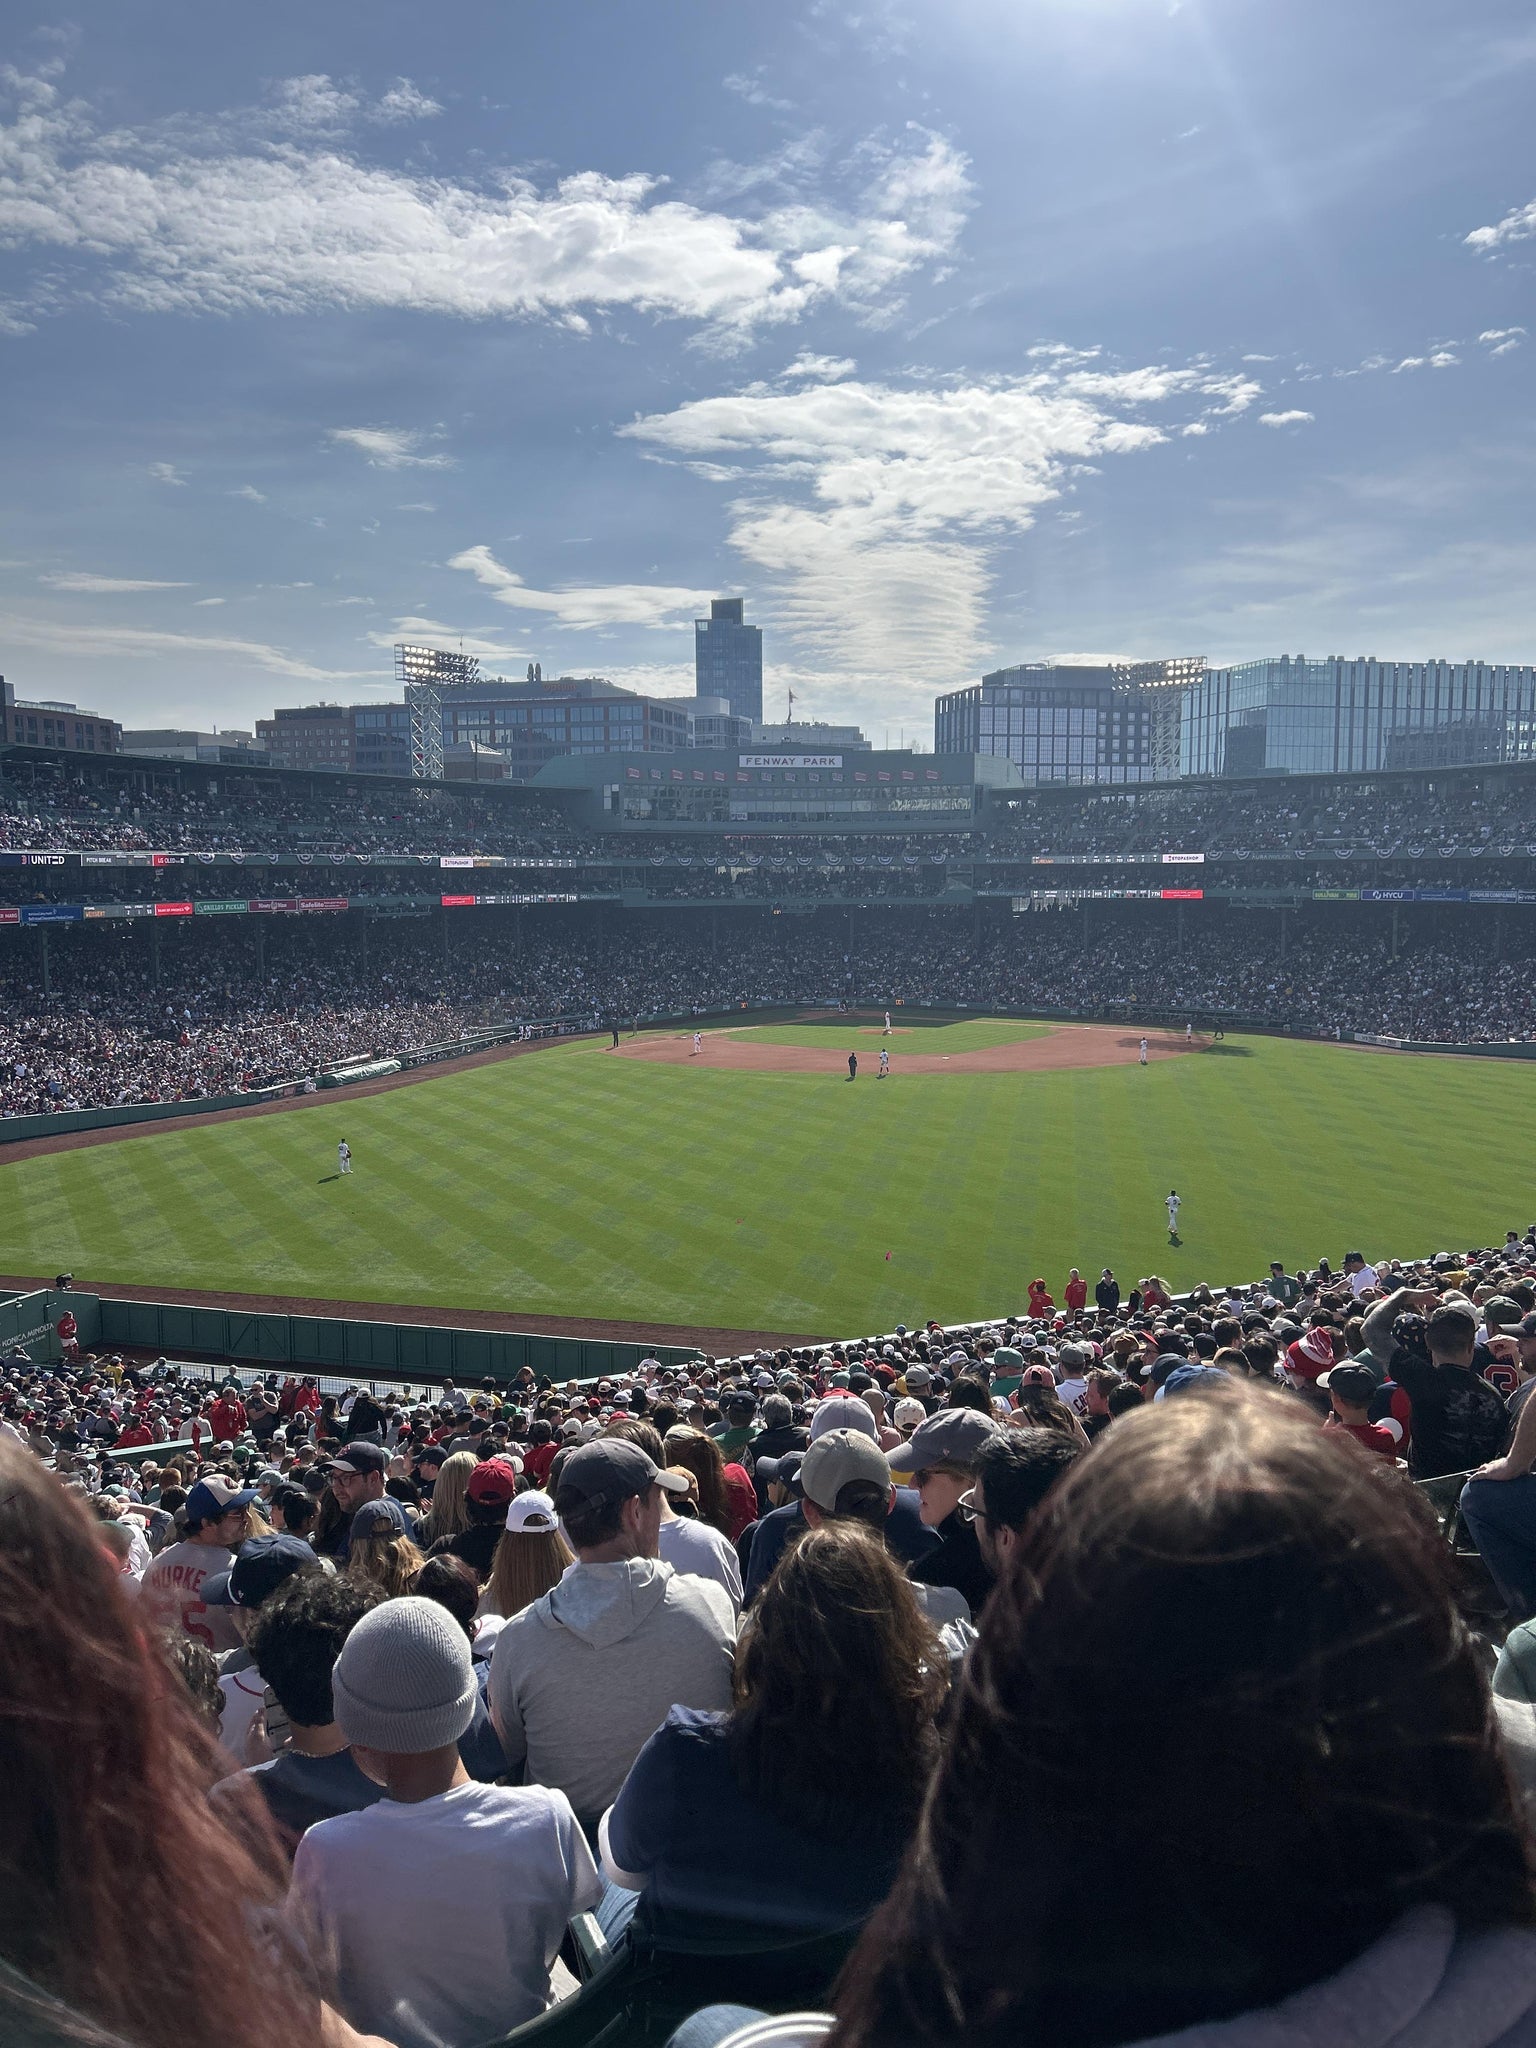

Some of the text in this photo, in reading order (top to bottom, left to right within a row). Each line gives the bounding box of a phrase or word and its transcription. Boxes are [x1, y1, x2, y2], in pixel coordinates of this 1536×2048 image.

[745, 757, 837, 766] FENWAY PARK
[31, 855, 65, 865] UNITED
[1, 1332, 27, 1347] KONICA
[26, 1321, 55, 1339] MINOLTA
[157, 1368, 169, 1377] 52
